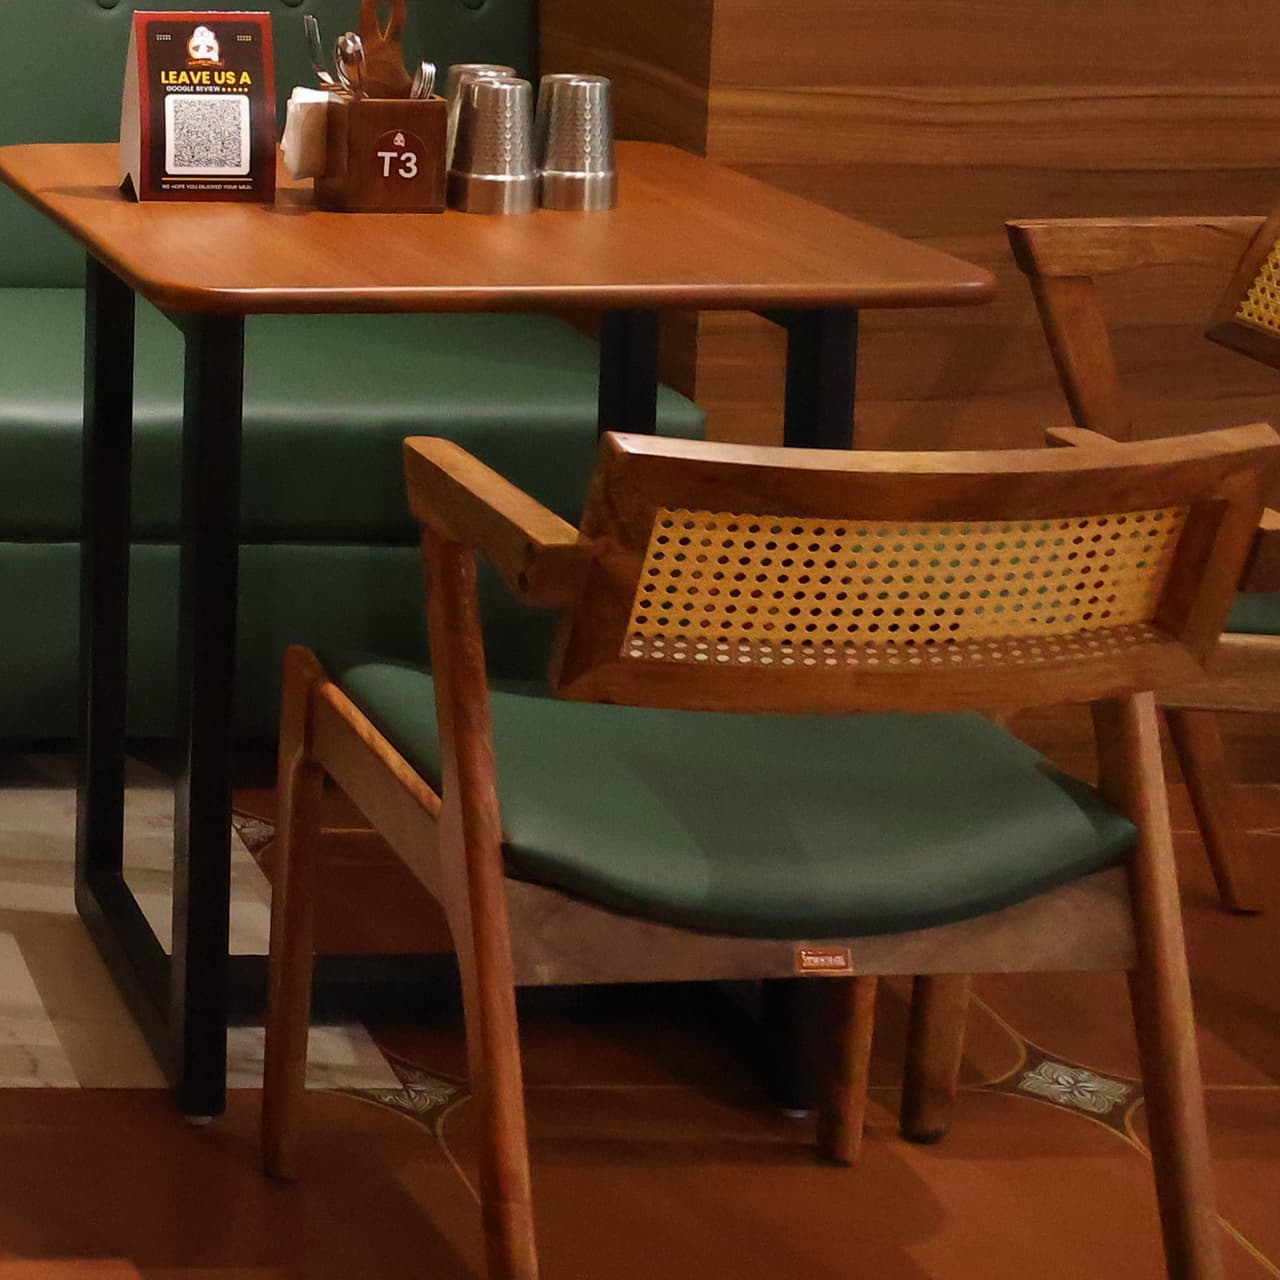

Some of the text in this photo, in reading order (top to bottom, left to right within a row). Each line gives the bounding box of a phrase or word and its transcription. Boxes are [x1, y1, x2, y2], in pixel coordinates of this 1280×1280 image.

[161, 71, 252, 85] LEAVE US A
[377, 151, 418, 179] T3
